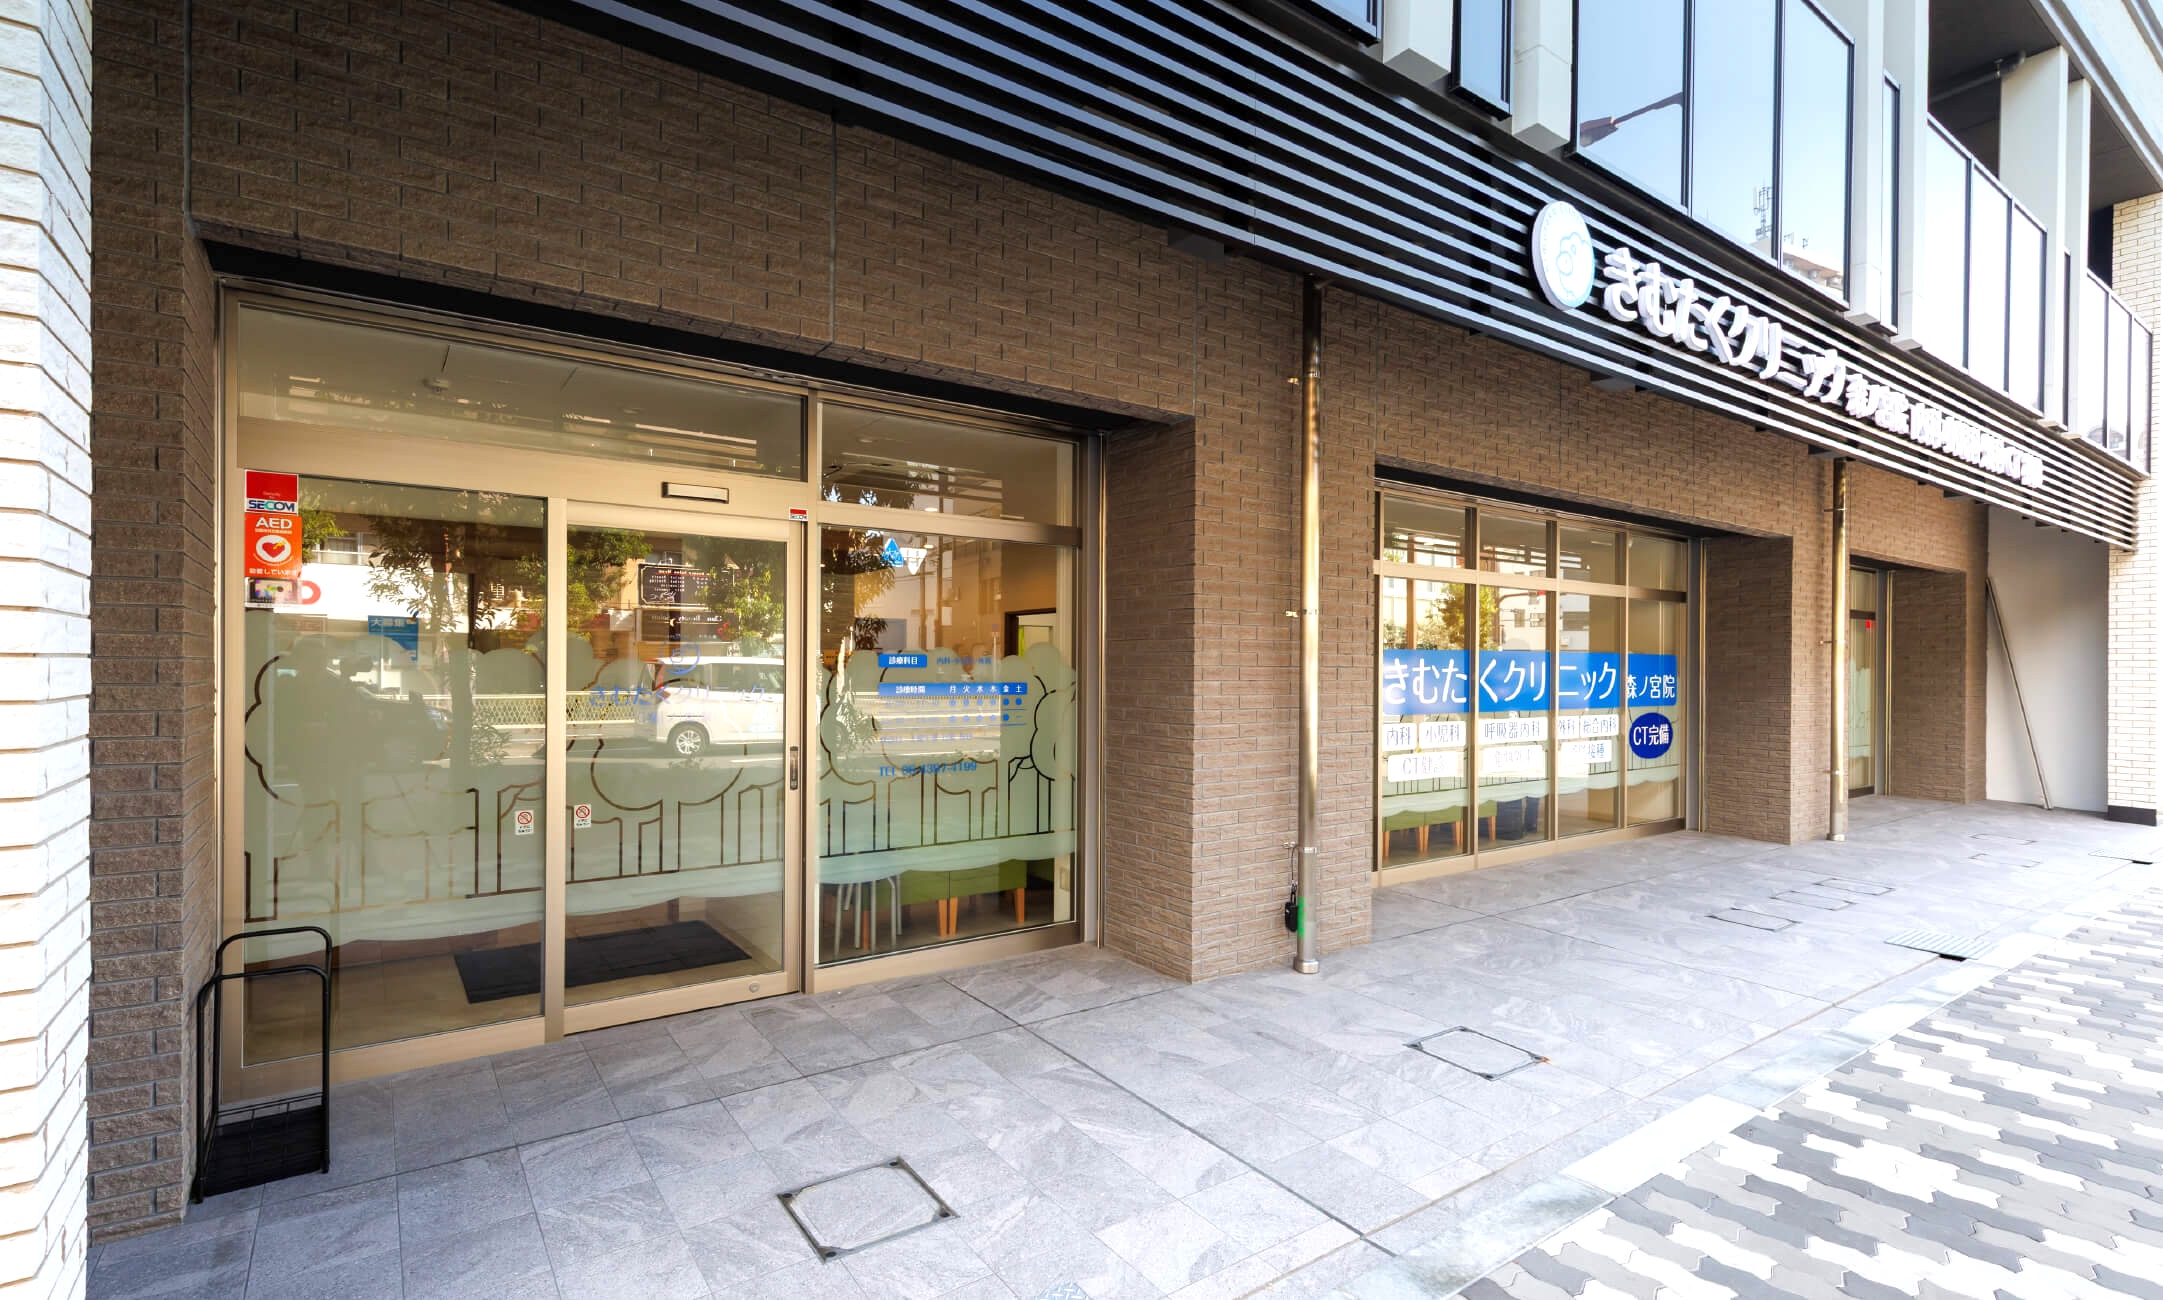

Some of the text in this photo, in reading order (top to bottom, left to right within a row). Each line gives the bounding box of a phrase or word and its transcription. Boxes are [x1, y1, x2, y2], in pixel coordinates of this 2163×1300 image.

[248, 500, 295, 512] SECOM
[256, 517, 293, 529] AED
[1002, 684, 1009, 693] 金
[1015, 684, 1022, 693] 土
[1384, 657, 1675, 704] きむたくクリニック 森ノ宮院
[1386, 727, 1411, 746] 内科
[1425, 723, 1460, 743] 小児科
[1484, 719, 1540, 740] 呼吸器内科
[1583, 716, 1617, 734] 総合内科
[1632, 723, 1671, 747] CT完備
